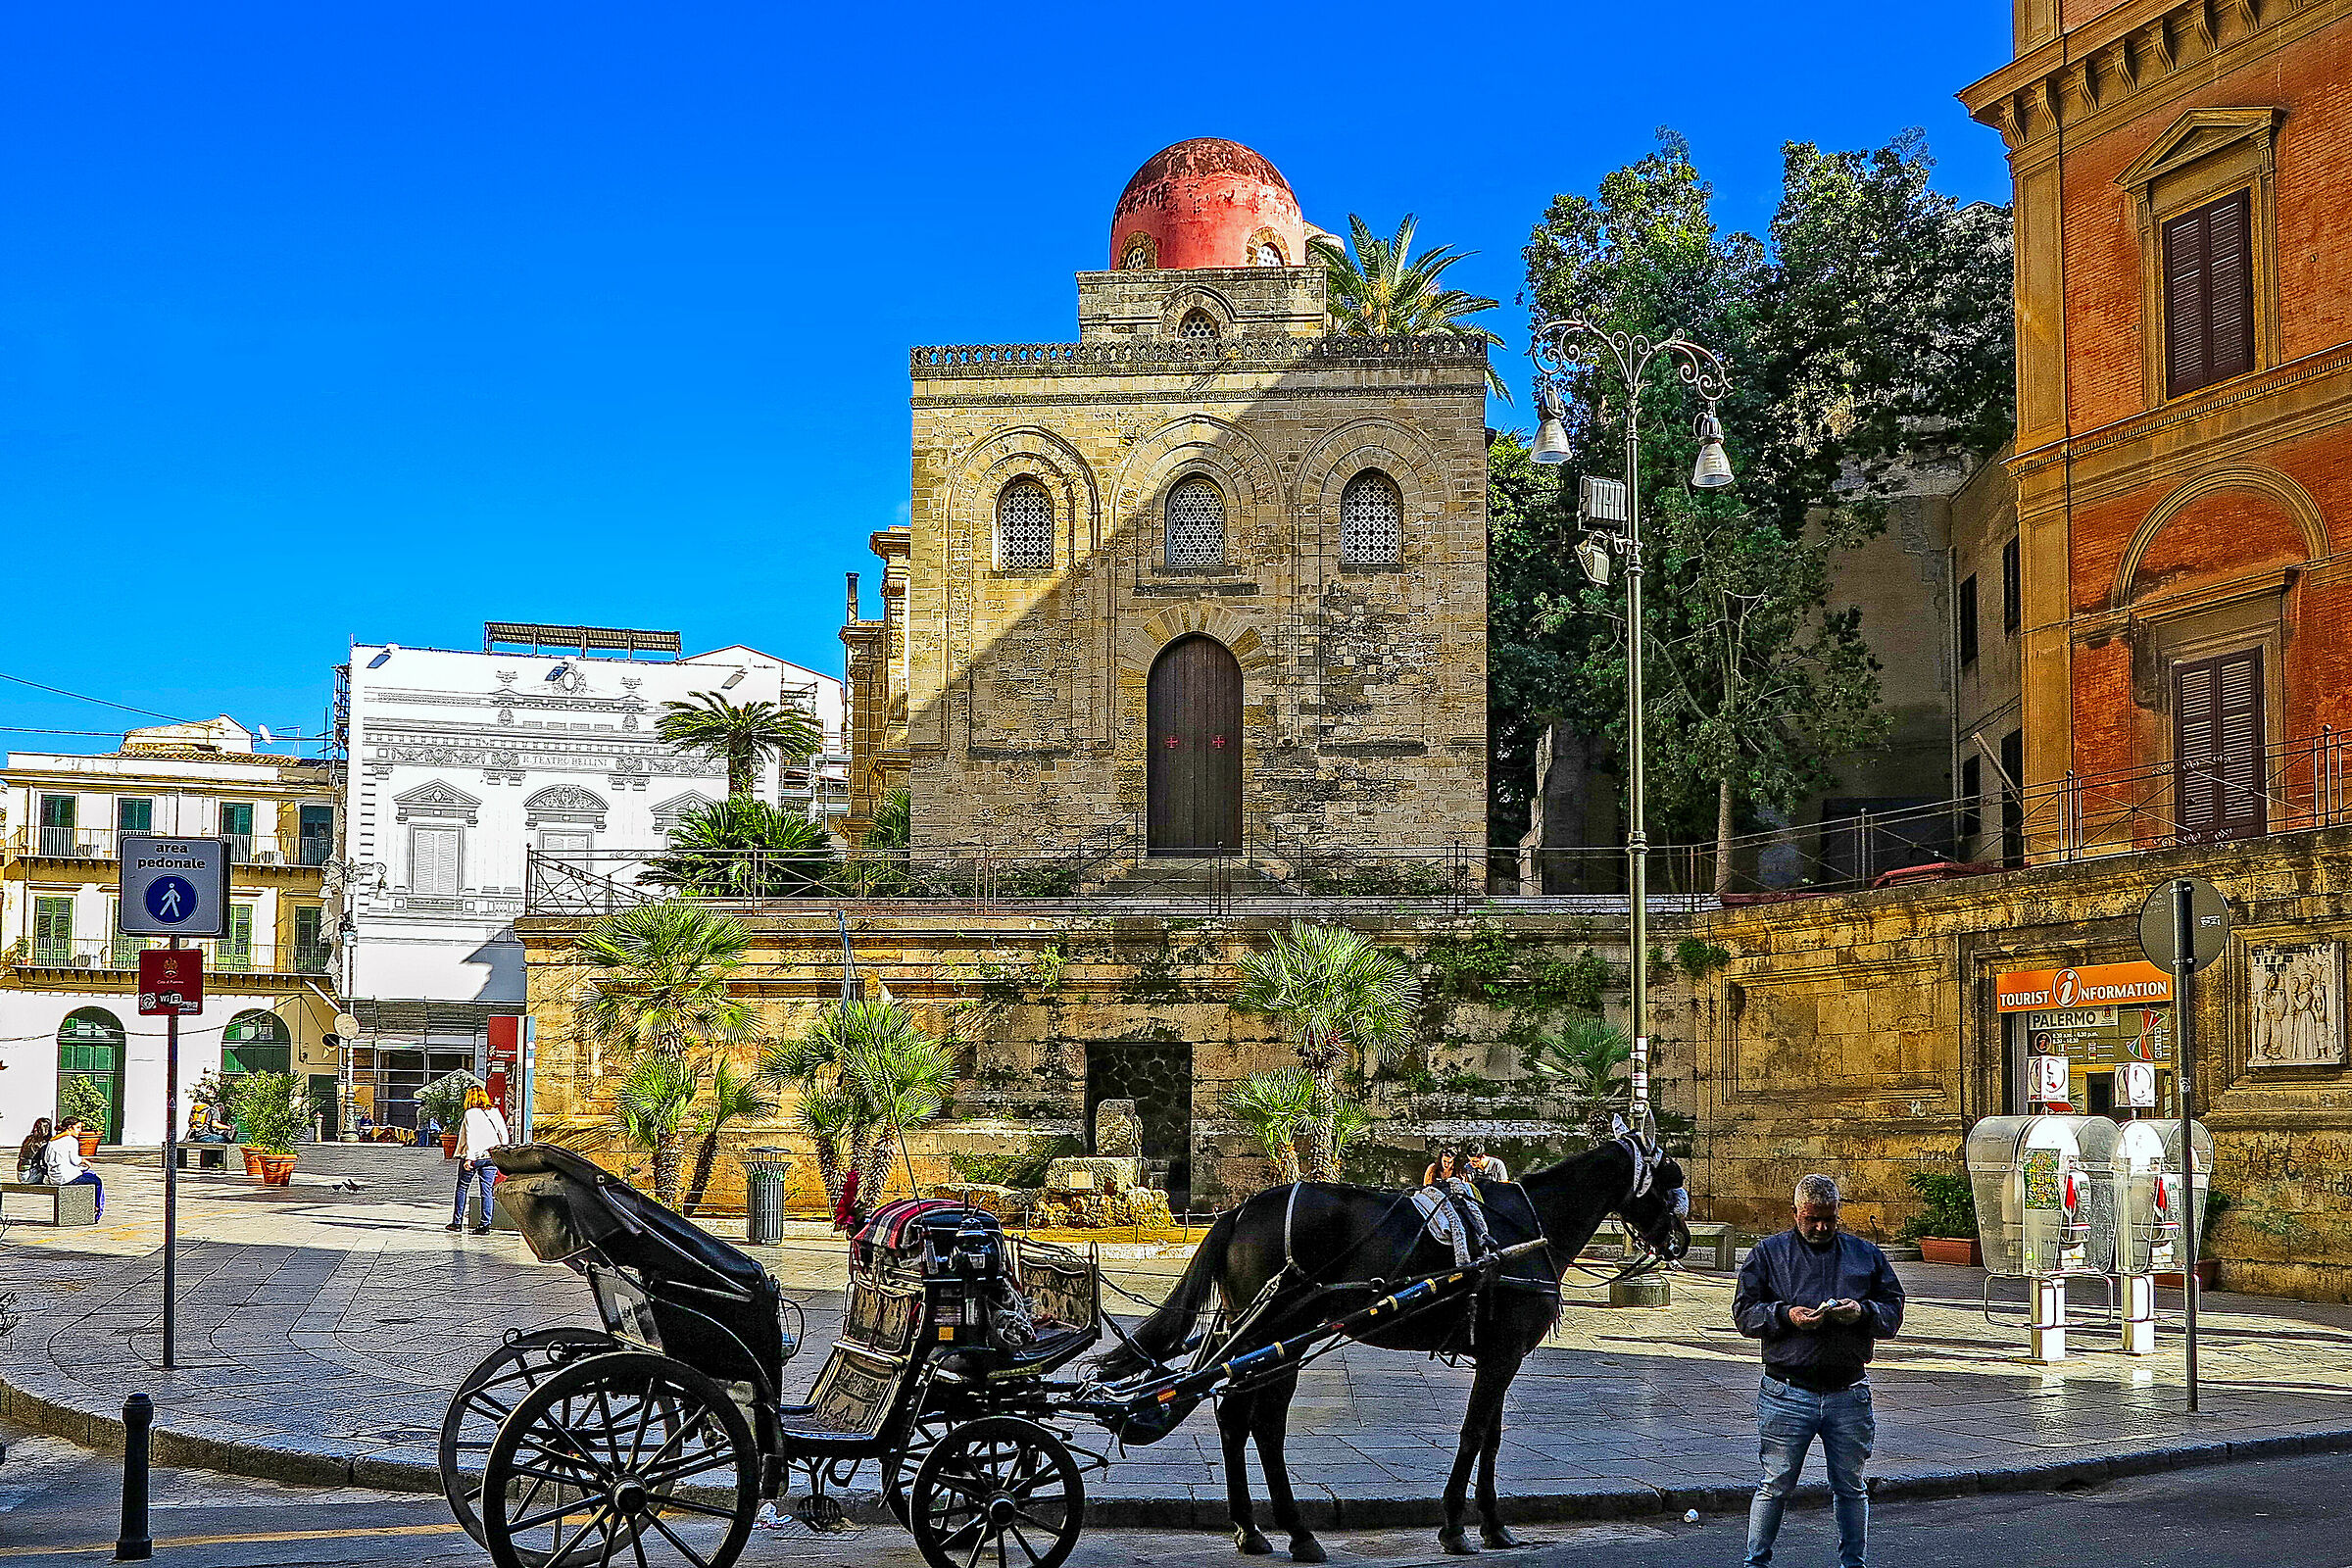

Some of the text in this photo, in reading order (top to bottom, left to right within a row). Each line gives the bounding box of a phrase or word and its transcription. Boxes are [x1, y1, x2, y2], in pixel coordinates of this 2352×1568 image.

[532, 756, 569, 765] TEATRO
[571, 758, 608, 767] BELLINI
[155, 843, 189, 854] area
[137, 857, 206, 869] pedonale
[1999, 990, 2050, 1007] TOURIST
[2033, 1010, 2096, 1029] PALERMO
